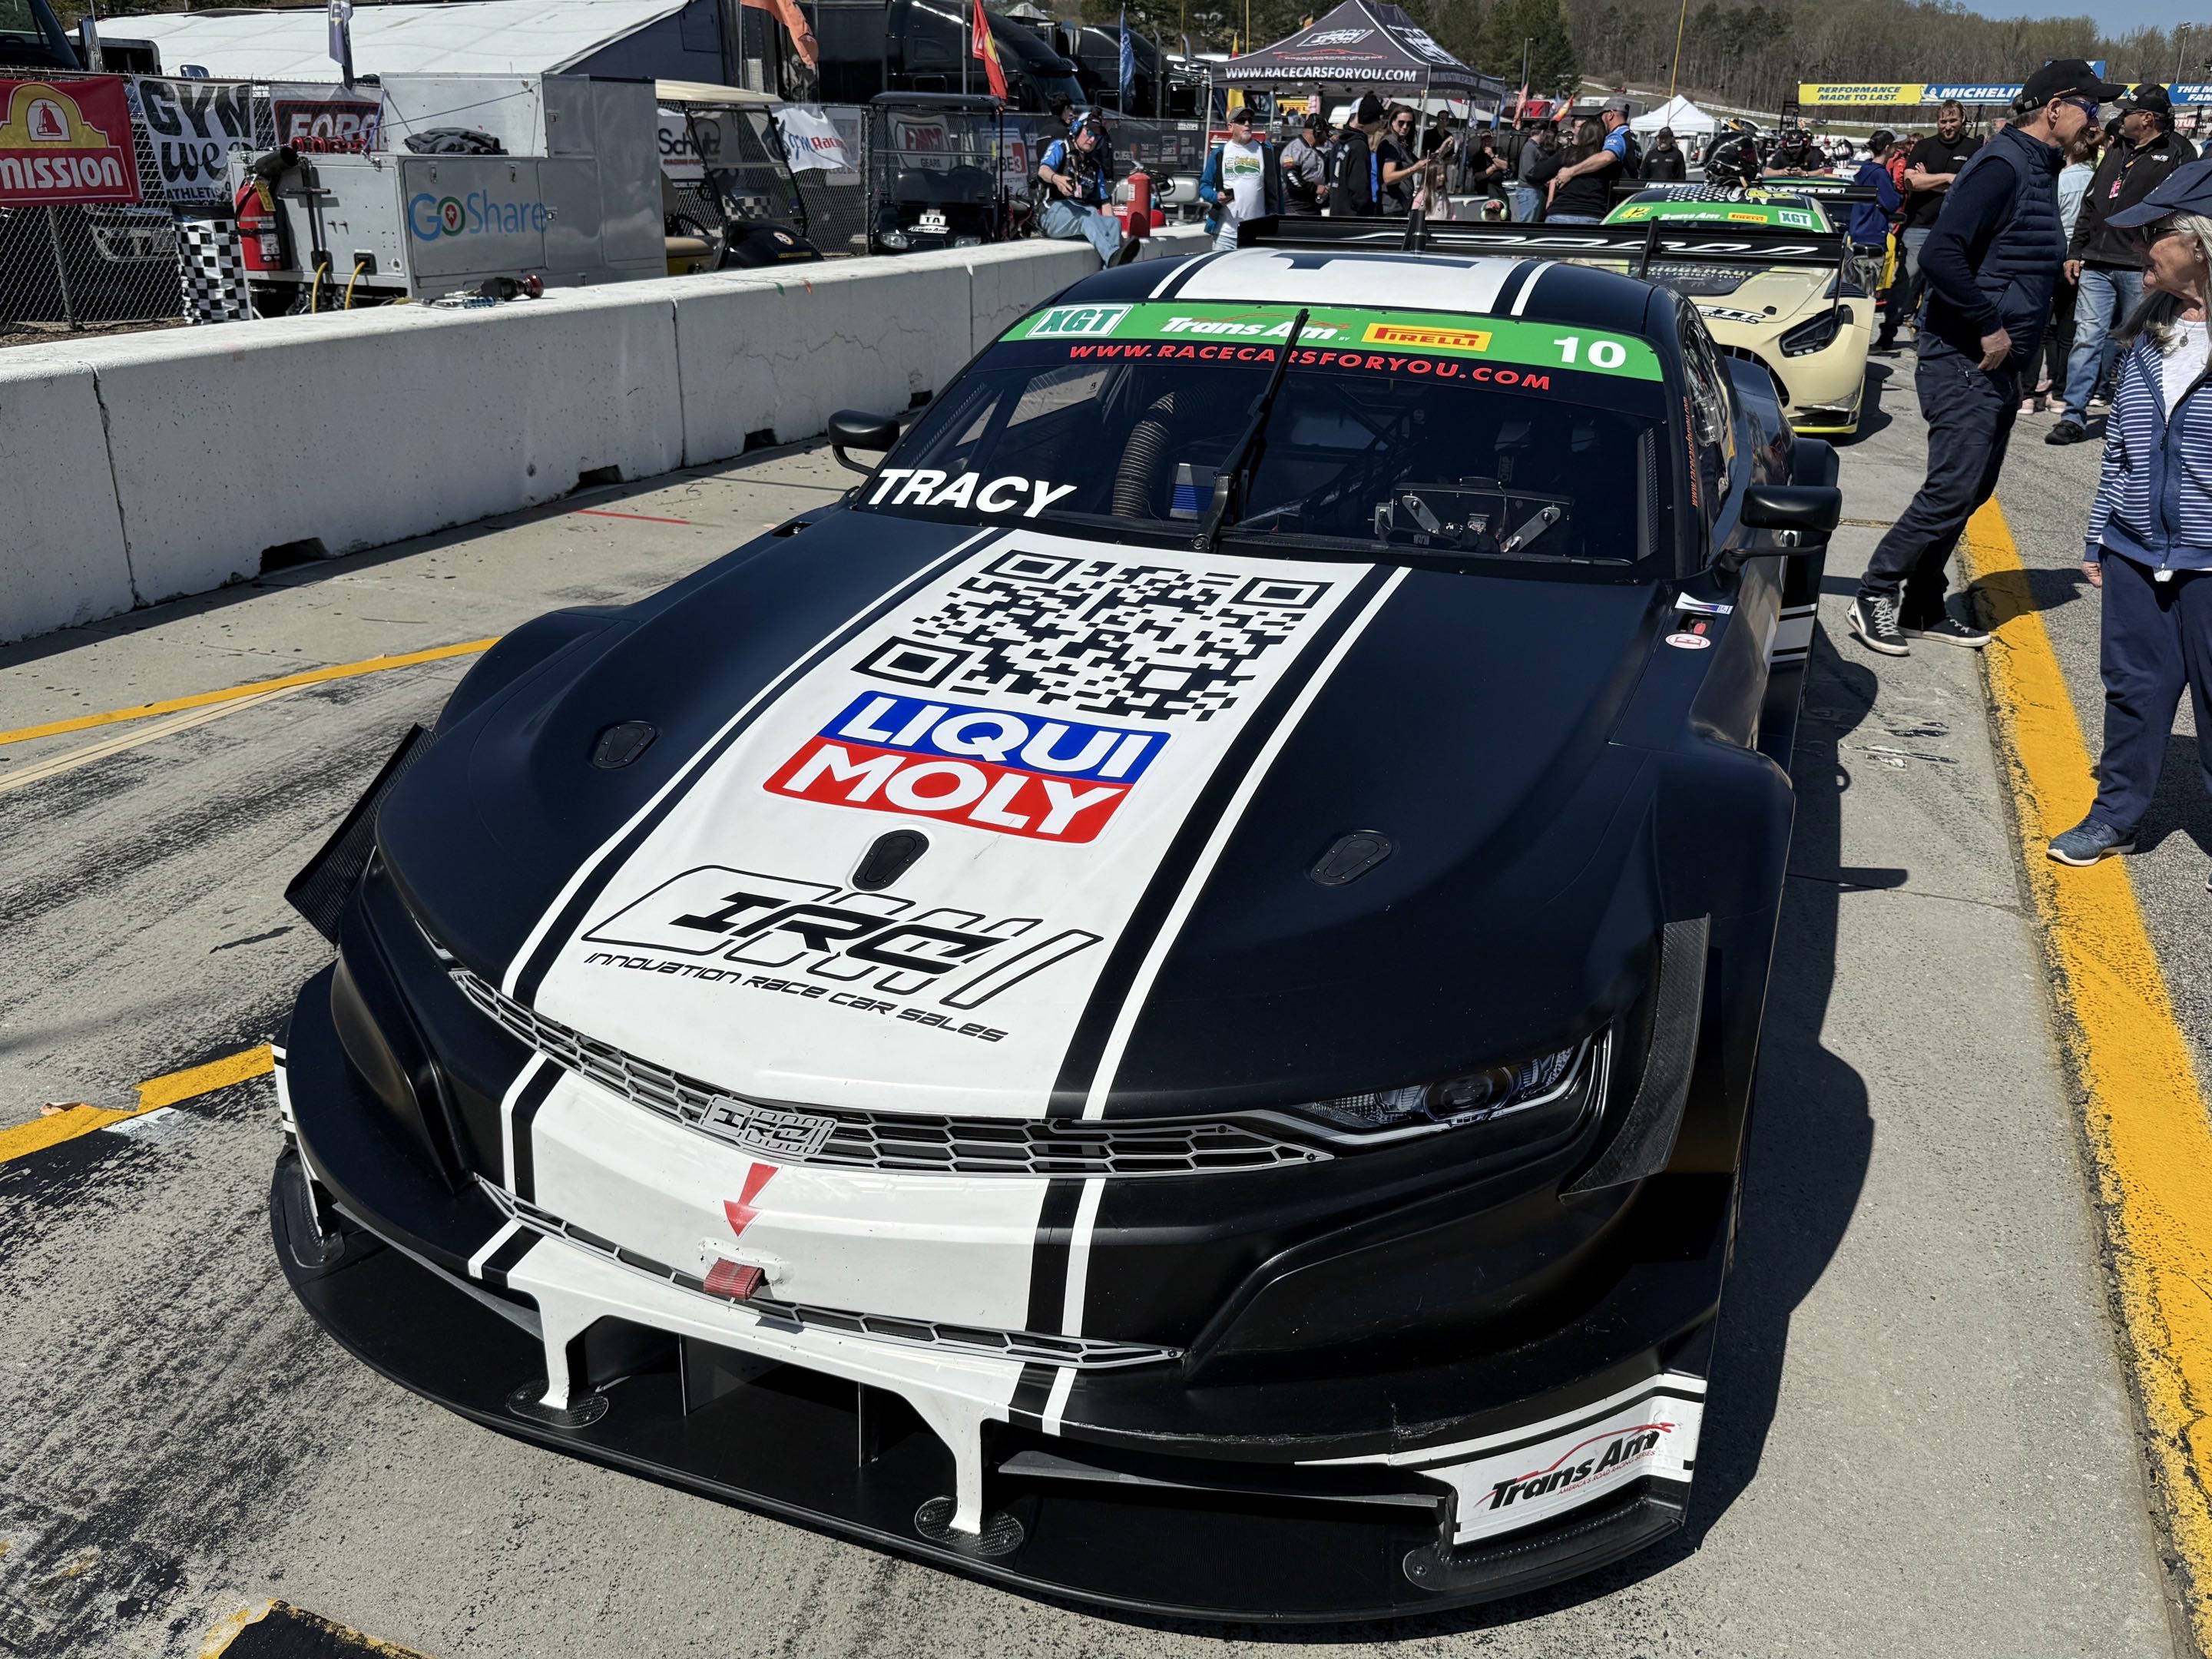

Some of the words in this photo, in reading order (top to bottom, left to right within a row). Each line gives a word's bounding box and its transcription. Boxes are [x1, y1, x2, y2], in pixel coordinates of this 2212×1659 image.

[1225, 67, 1416, 82] WWW.RACECARSFORYOU.COM
[2177, 85, 2202, 94] THE
[0, 157, 123, 189] MISSION
[925, 216, 941, 224] TA
[1781, 212, 1810, 224] XGT
[1044, 308, 1122, 333] XGT
[1160, 317, 1262, 336] Trans
[1260, 321, 1338, 340] Am
[1376, 327, 1480, 346] PIRELLI
[1069, 345, 1550, 390] WWW.RACECARSFORYOU.COM
[1553, 336, 1628, 369] 10
[868, 469, 1078, 518] TRACY
[838, 696, 1154, 778] LIQUI
[782, 744, 1127, 836] MOLY
[584, 952, 743, 984] INNOVATION
[741, 975, 830, 999] RACE
[827, 992, 899, 1016] CAR
[896, 1008, 1010, 1043] SALES
[1489, 1458, 1595, 1511] Trans
[1593, 1429, 1660, 1475] Am
[1557, 1476, 1592, 1495] AMERICA'S
[1591, 1469, 1611, 1482] ROAD
[1611, 1458, 1635, 1473] RACING
[1634, 1449, 1657, 1461] SERIES
